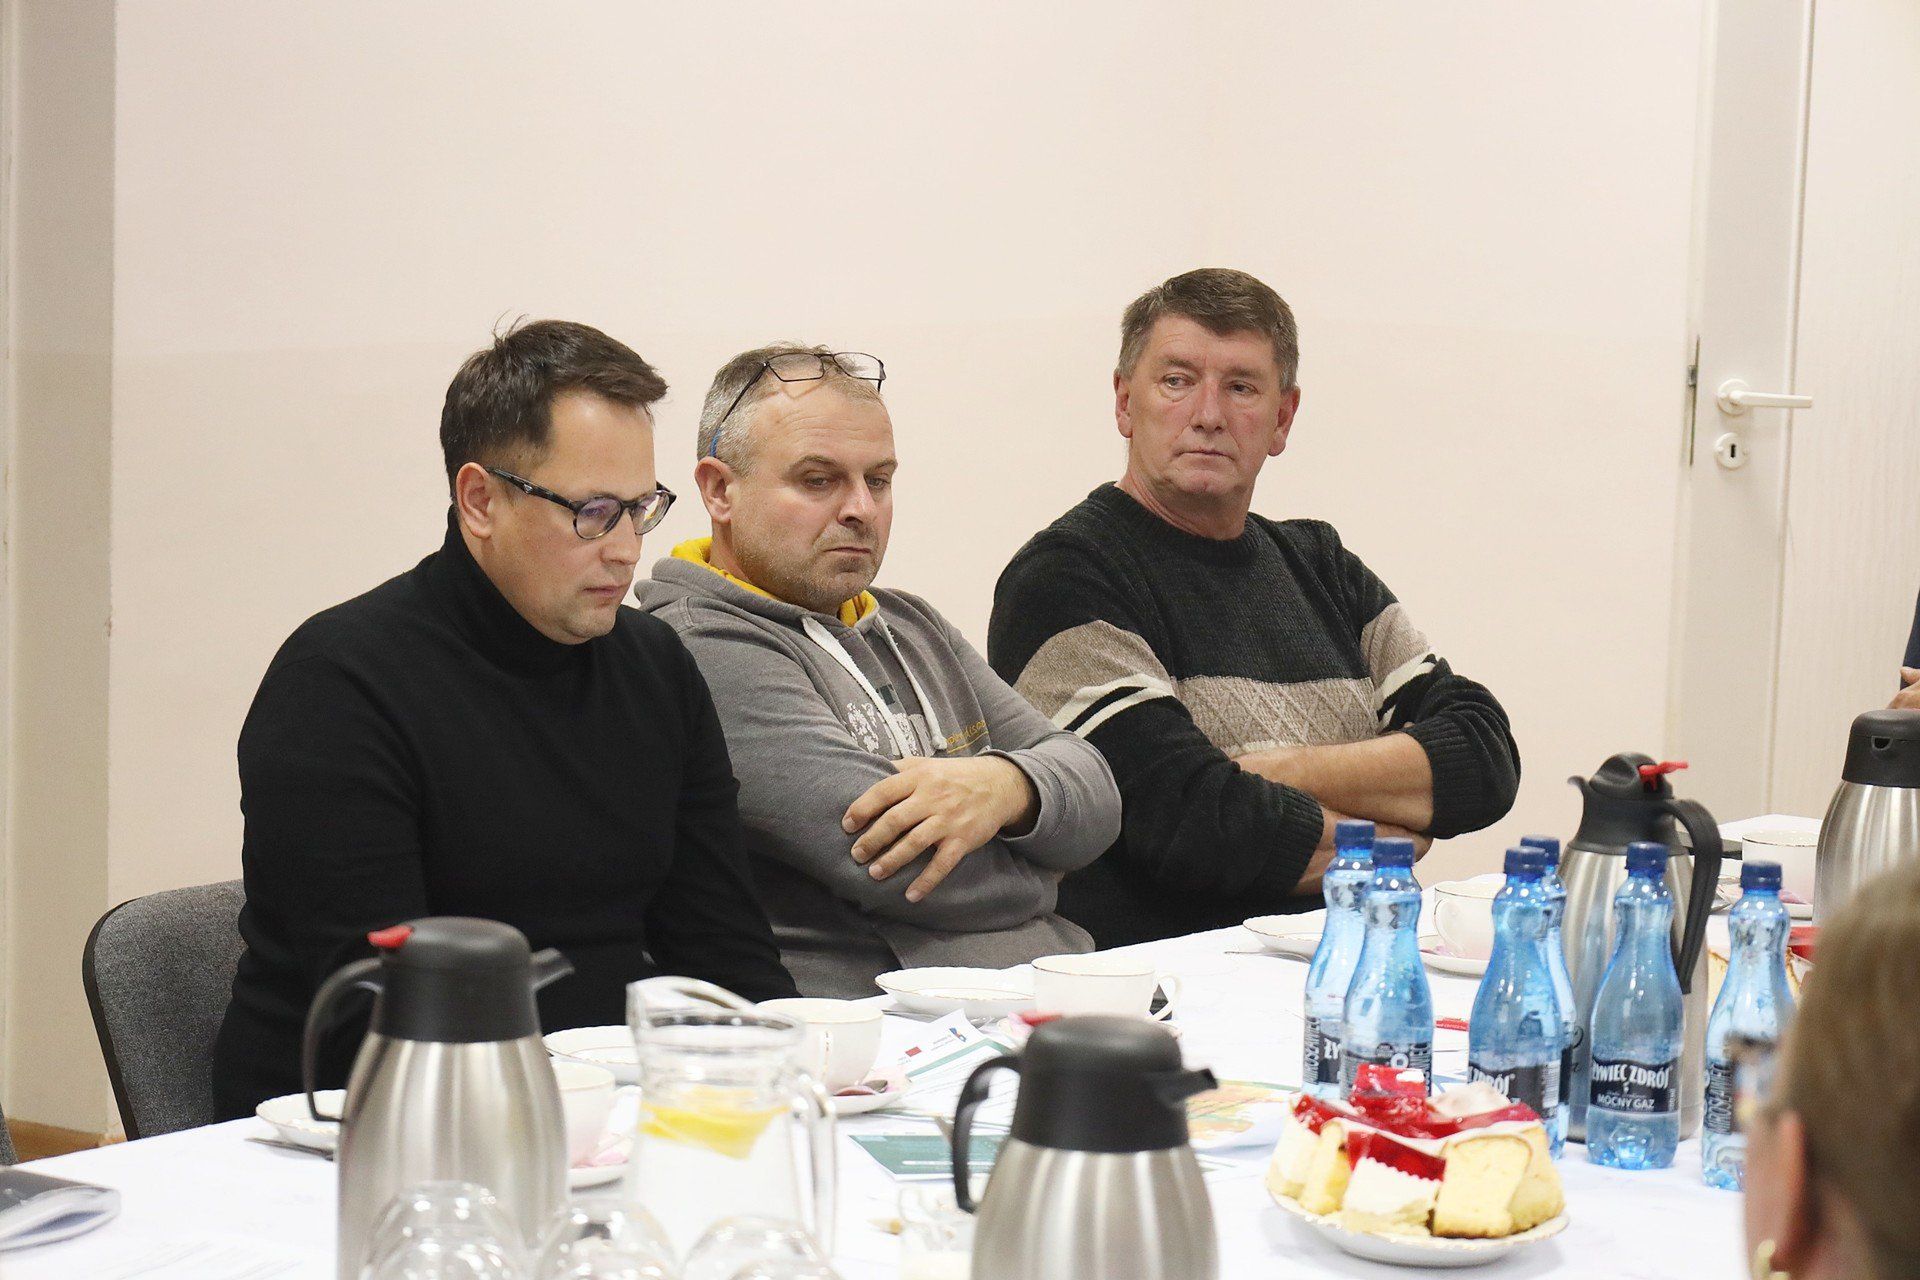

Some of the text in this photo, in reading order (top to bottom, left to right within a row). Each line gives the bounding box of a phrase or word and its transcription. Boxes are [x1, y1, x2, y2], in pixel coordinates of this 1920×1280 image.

[1629, 1065, 1670, 1089] ZDRÓJ
[1597, 1093, 1631, 1108] MOCNY
[1632, 1098, 1655, 1109] GAZ
